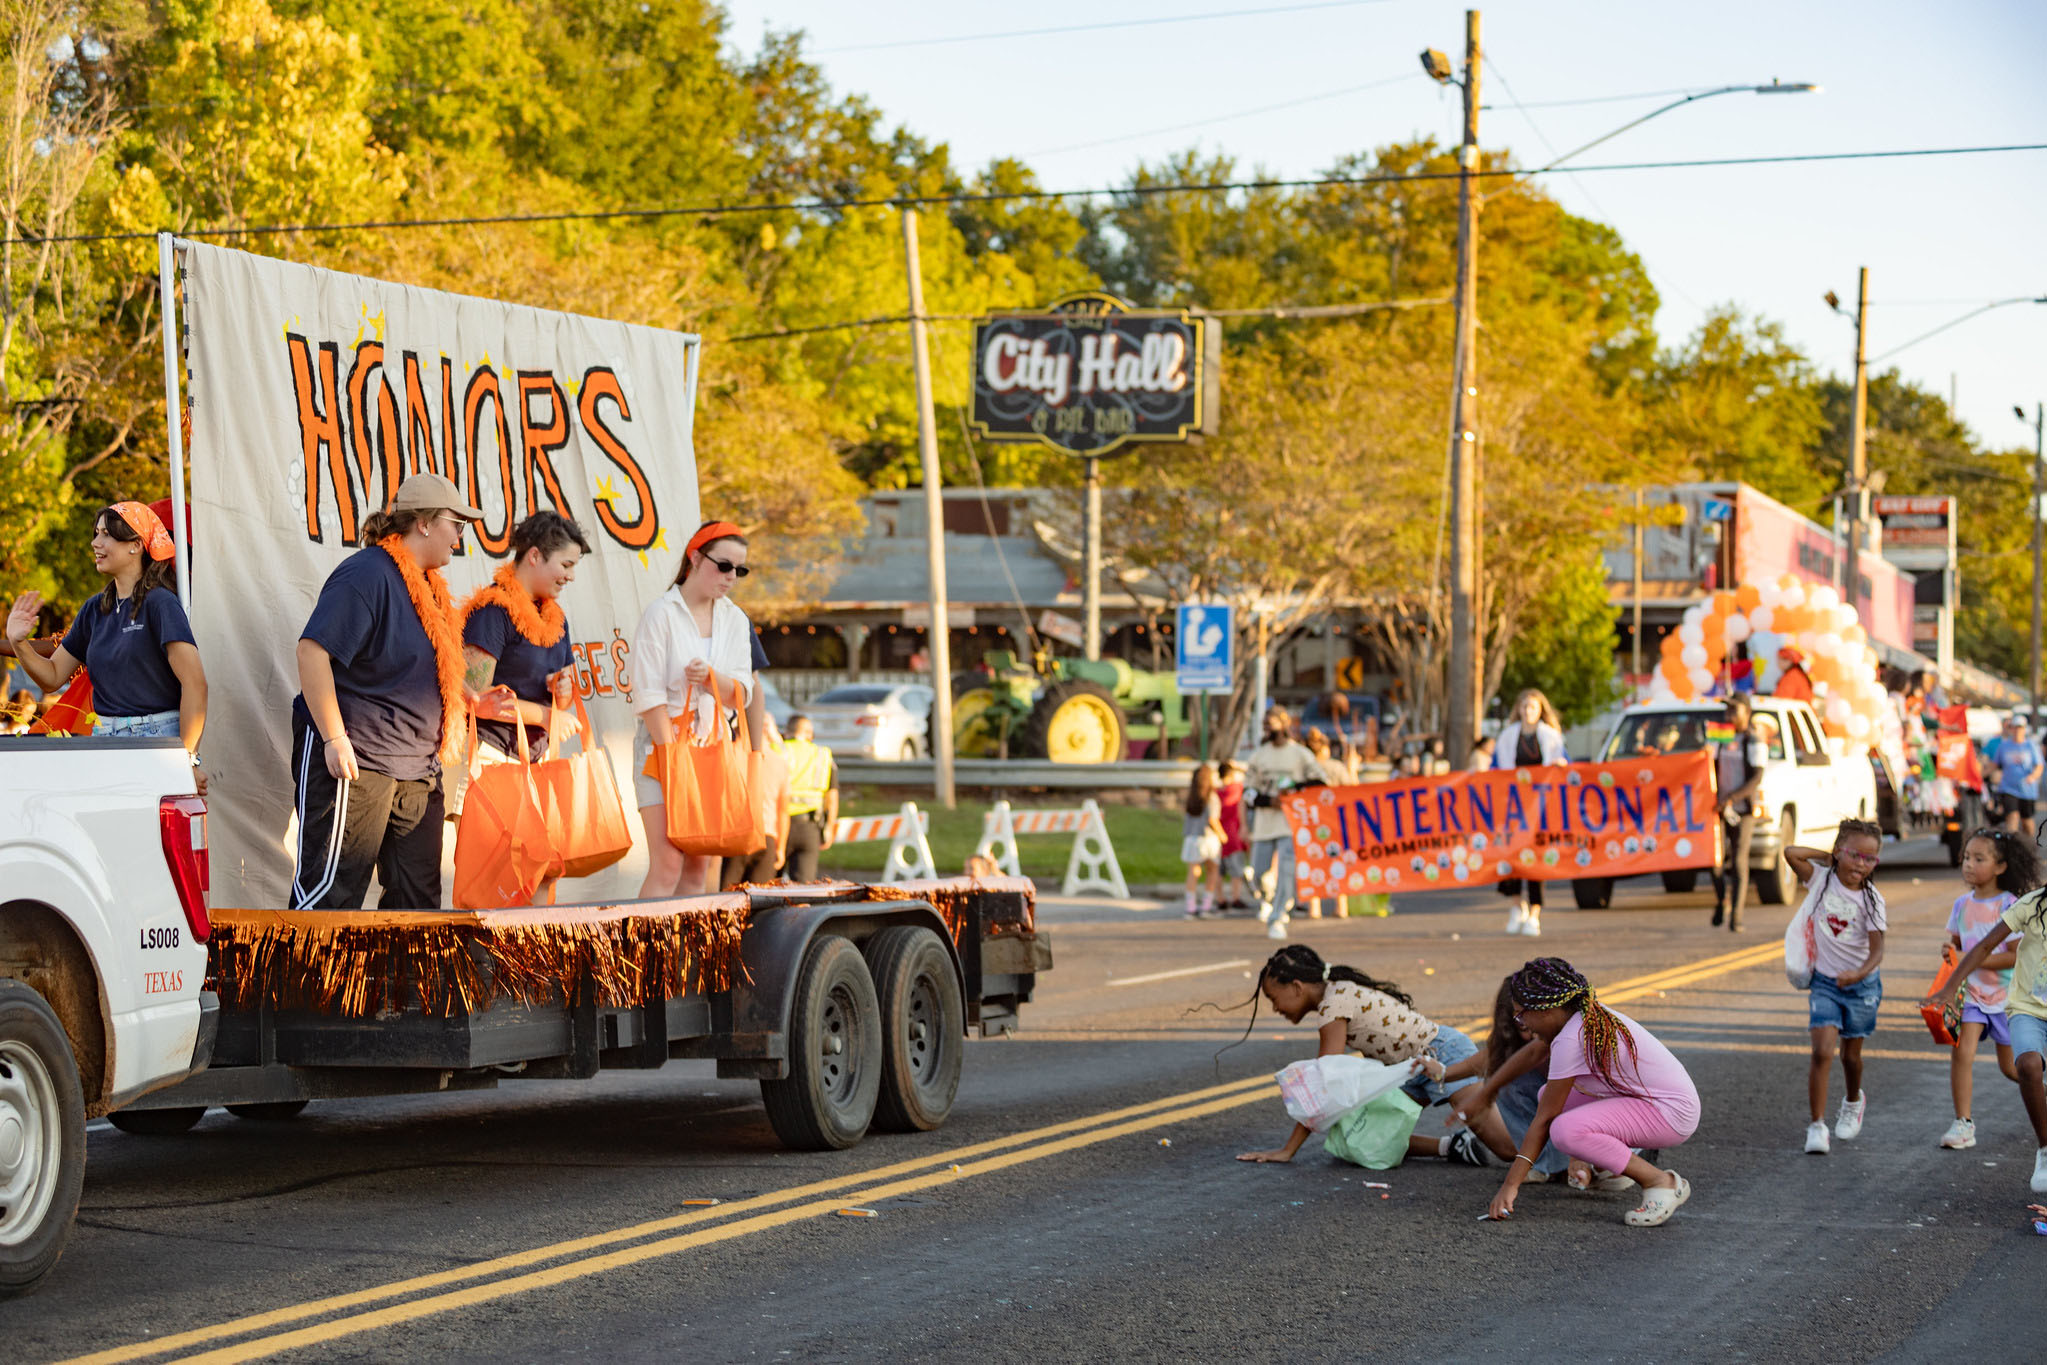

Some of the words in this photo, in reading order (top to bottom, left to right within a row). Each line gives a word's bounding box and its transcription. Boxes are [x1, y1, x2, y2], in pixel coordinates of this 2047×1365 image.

[984, 332, 1072, 406] City
[1078, 332, 1187, 394] Hall
[286, 332, 659, 558] HONORS
[1337, 783, 1705, 850] INTERNATIONAL
[1357, 834, 1470, 861] COMMUNITY
[140, 927, 179, 949] LS008
[144, 969, 183, 994] TEXAS
